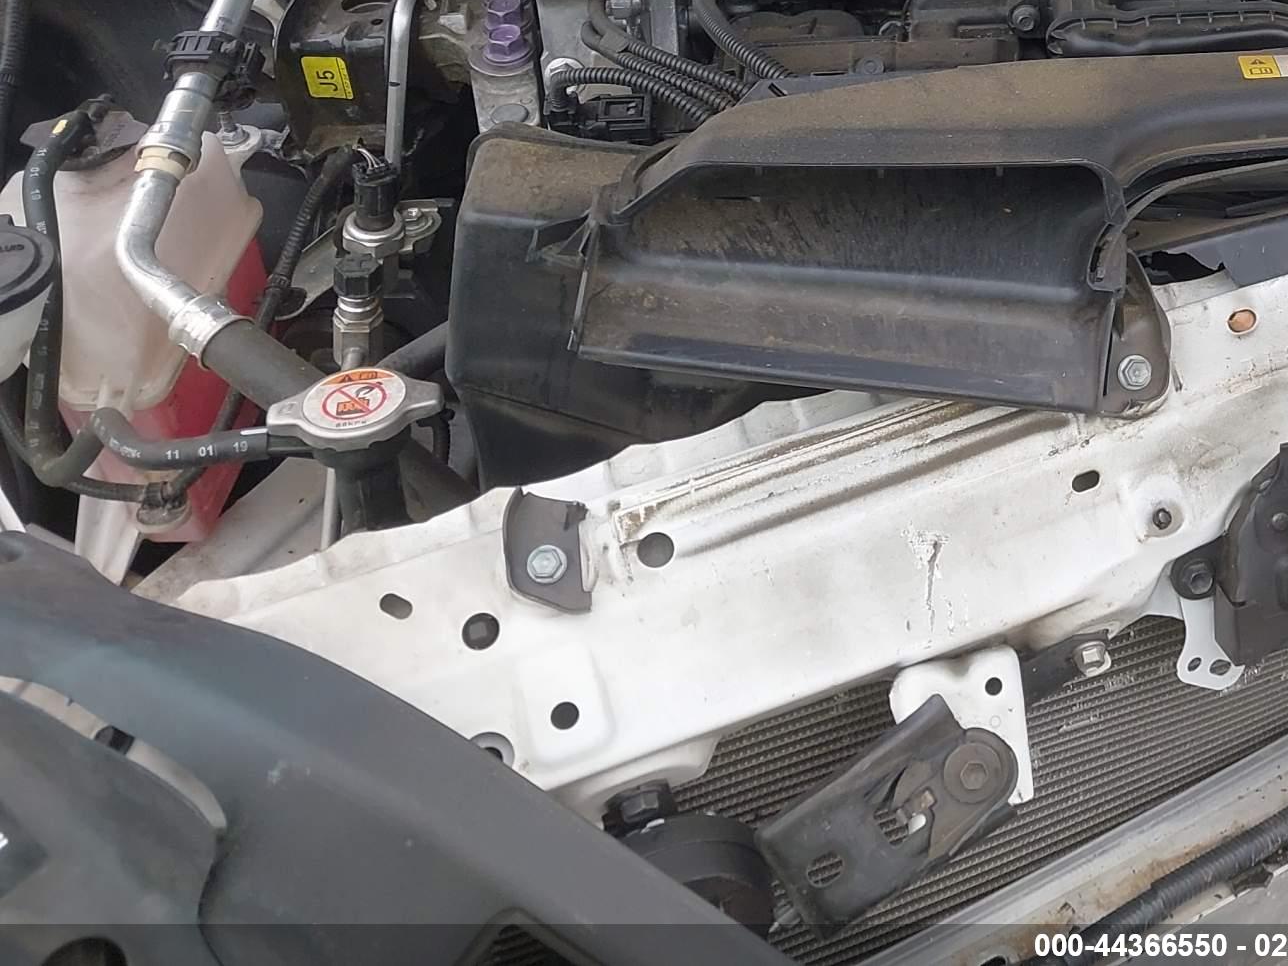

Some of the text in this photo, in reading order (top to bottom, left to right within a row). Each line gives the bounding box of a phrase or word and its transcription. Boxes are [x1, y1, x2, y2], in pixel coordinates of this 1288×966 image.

[316, 70, 338, 92] J5
[165, 440, 249, 460] 11 01 19
